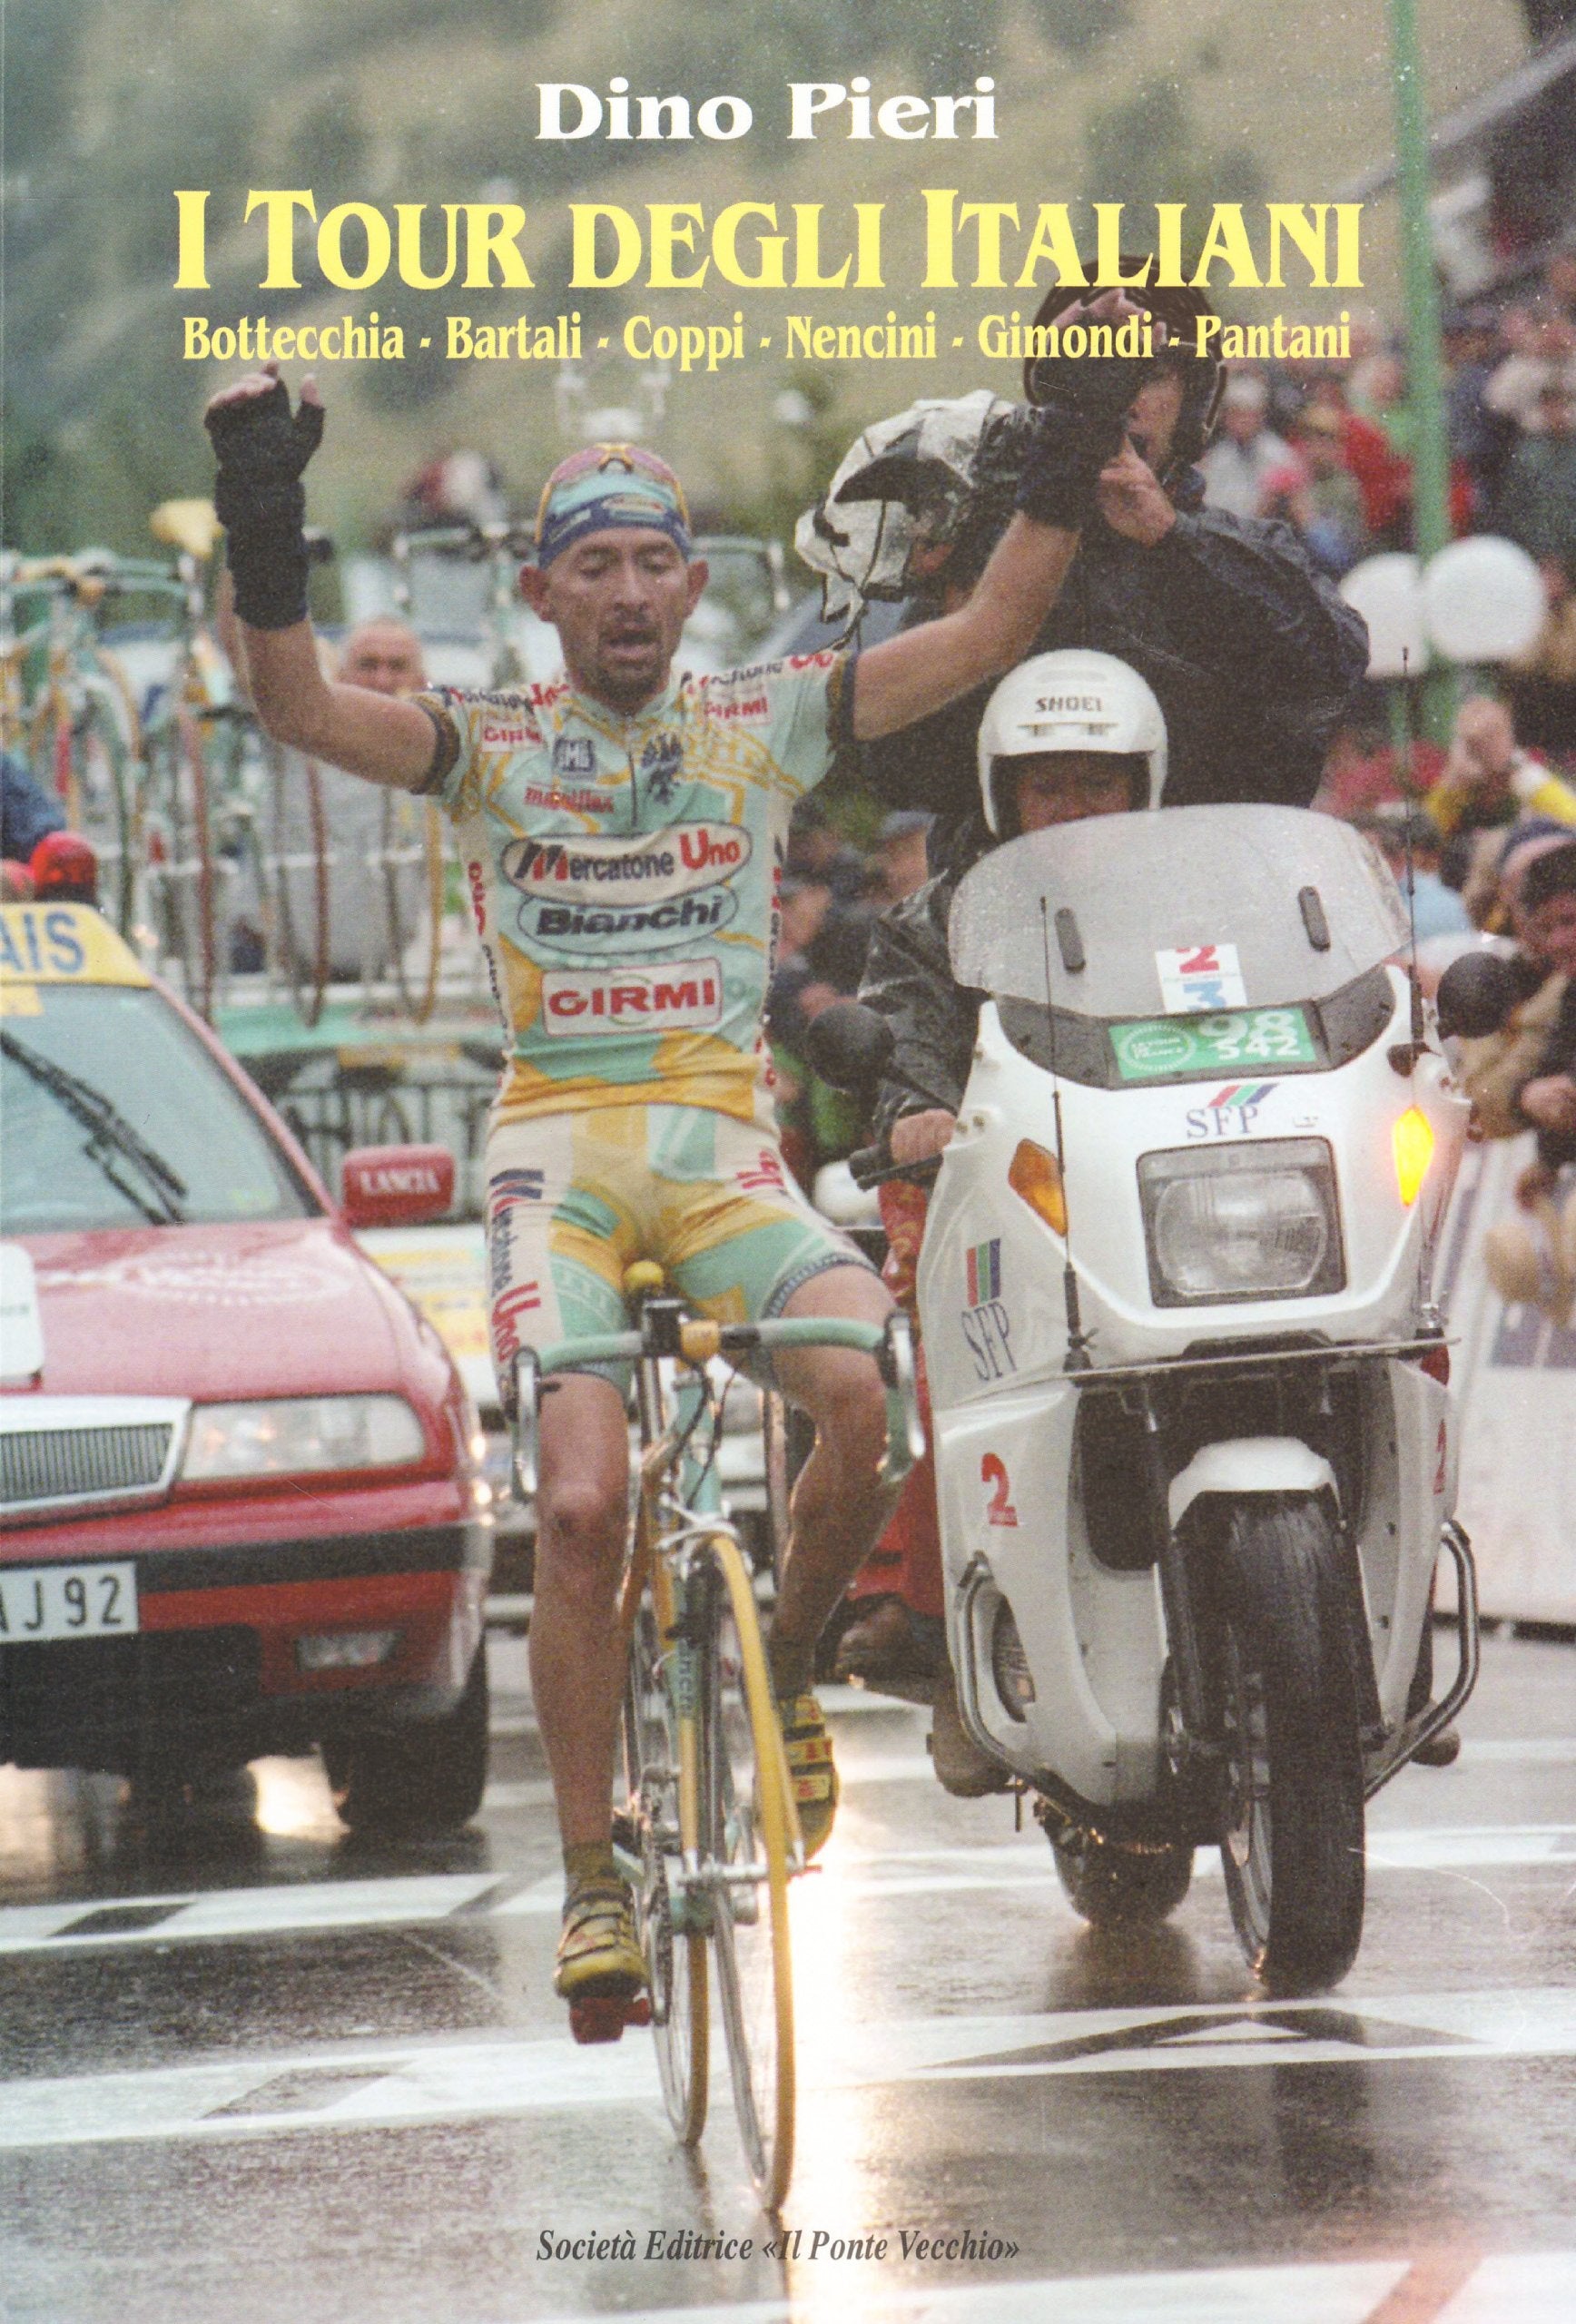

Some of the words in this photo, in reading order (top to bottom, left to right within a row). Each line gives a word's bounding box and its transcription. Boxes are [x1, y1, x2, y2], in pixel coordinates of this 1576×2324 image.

[1035, 696, 1105, 713] SHOEI
[514, 842, 675, 881] Mercatone
[680, 828, 741, 871] Uno
[537, 895, 723, 936] Bianchi
[548, 978, 715, 1016] GIRMI
[1198, 1010, 1298, 1043] 98
[1186, 1105, 1259, 1138] SFP
[960, 1300, 1017, 1383] SFP
[980, 1452, 1019, 1528] 2
